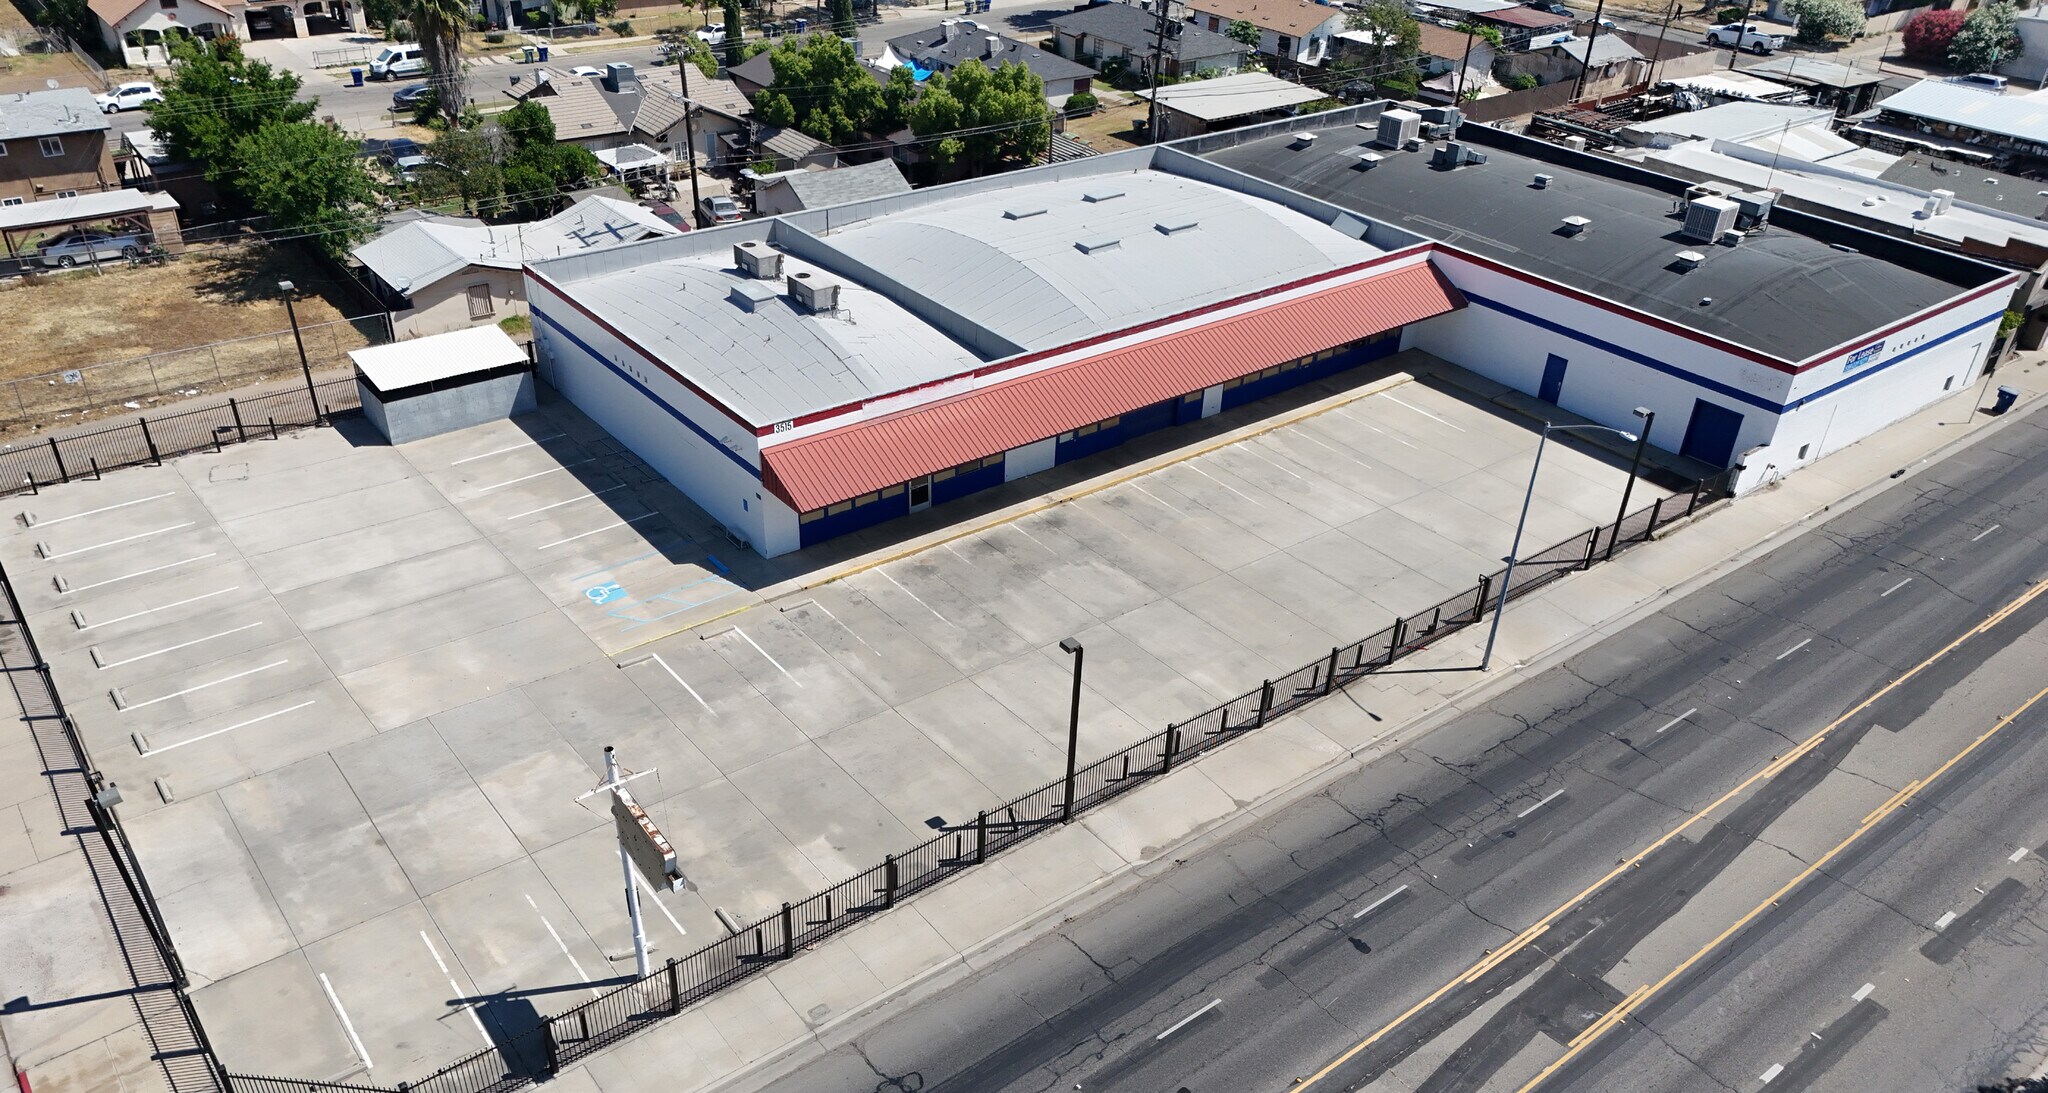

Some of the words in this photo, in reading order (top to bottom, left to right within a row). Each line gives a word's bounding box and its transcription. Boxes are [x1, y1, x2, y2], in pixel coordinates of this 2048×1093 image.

[1846, 354, 1858, 365] For
[1857, 347, 1874, 360] Lease
[775, 421, 792, 434] 3515
